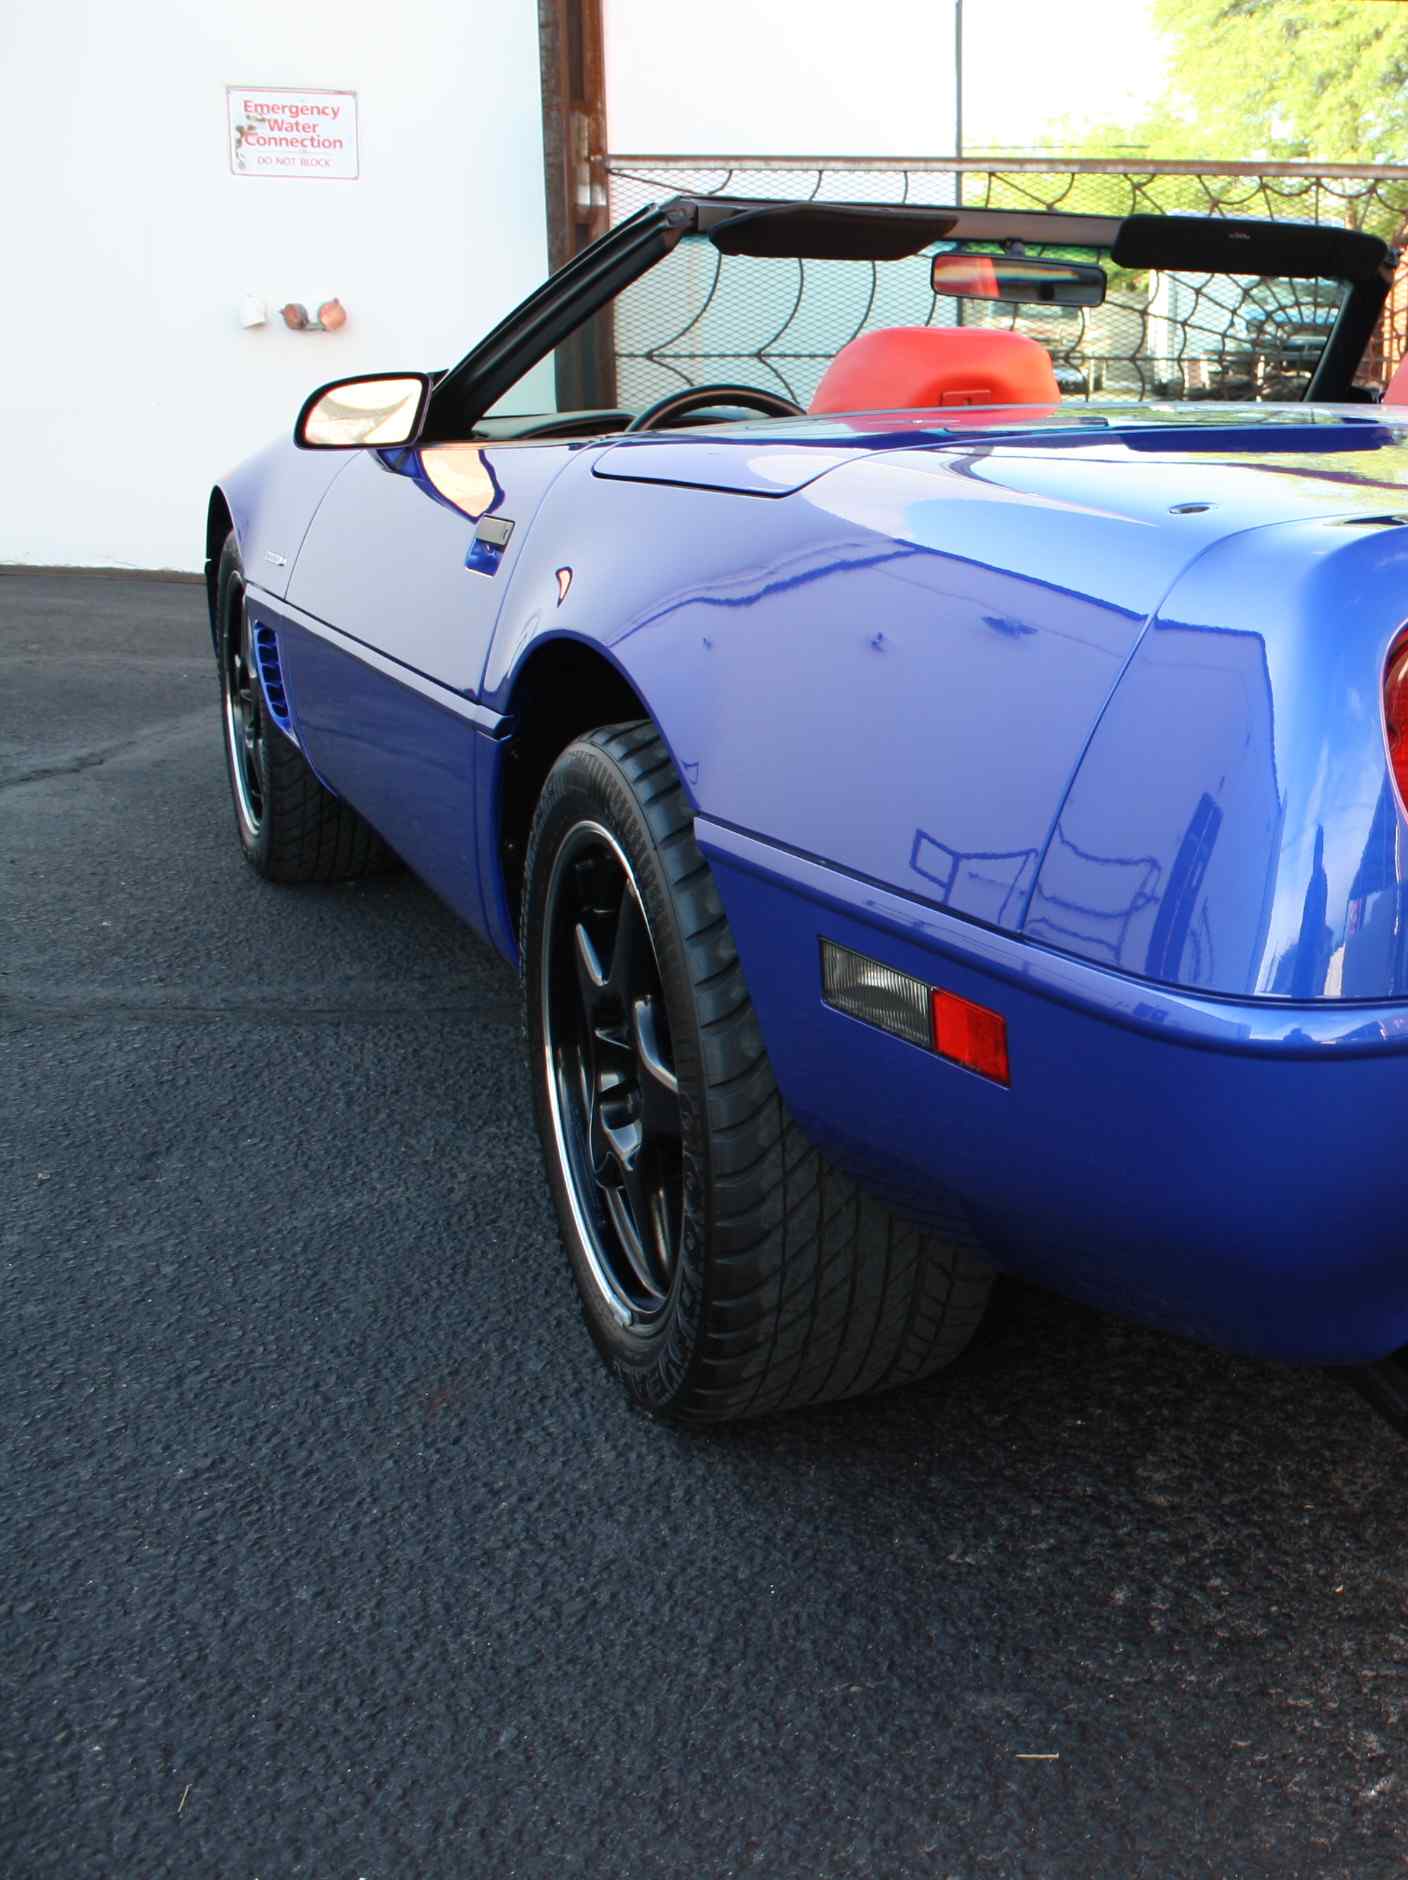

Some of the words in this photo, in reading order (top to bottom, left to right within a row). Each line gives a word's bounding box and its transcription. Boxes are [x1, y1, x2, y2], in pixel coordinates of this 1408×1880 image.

[243, 100, 340, 120] Emergency
[268, 119, 319, 133] Water
[244, 134, 343, 149] Connection
[257, 156, 273, 165] DO
[276, 157, 296, 166] NOT
[300, 157, 331, 167] BLOCK
